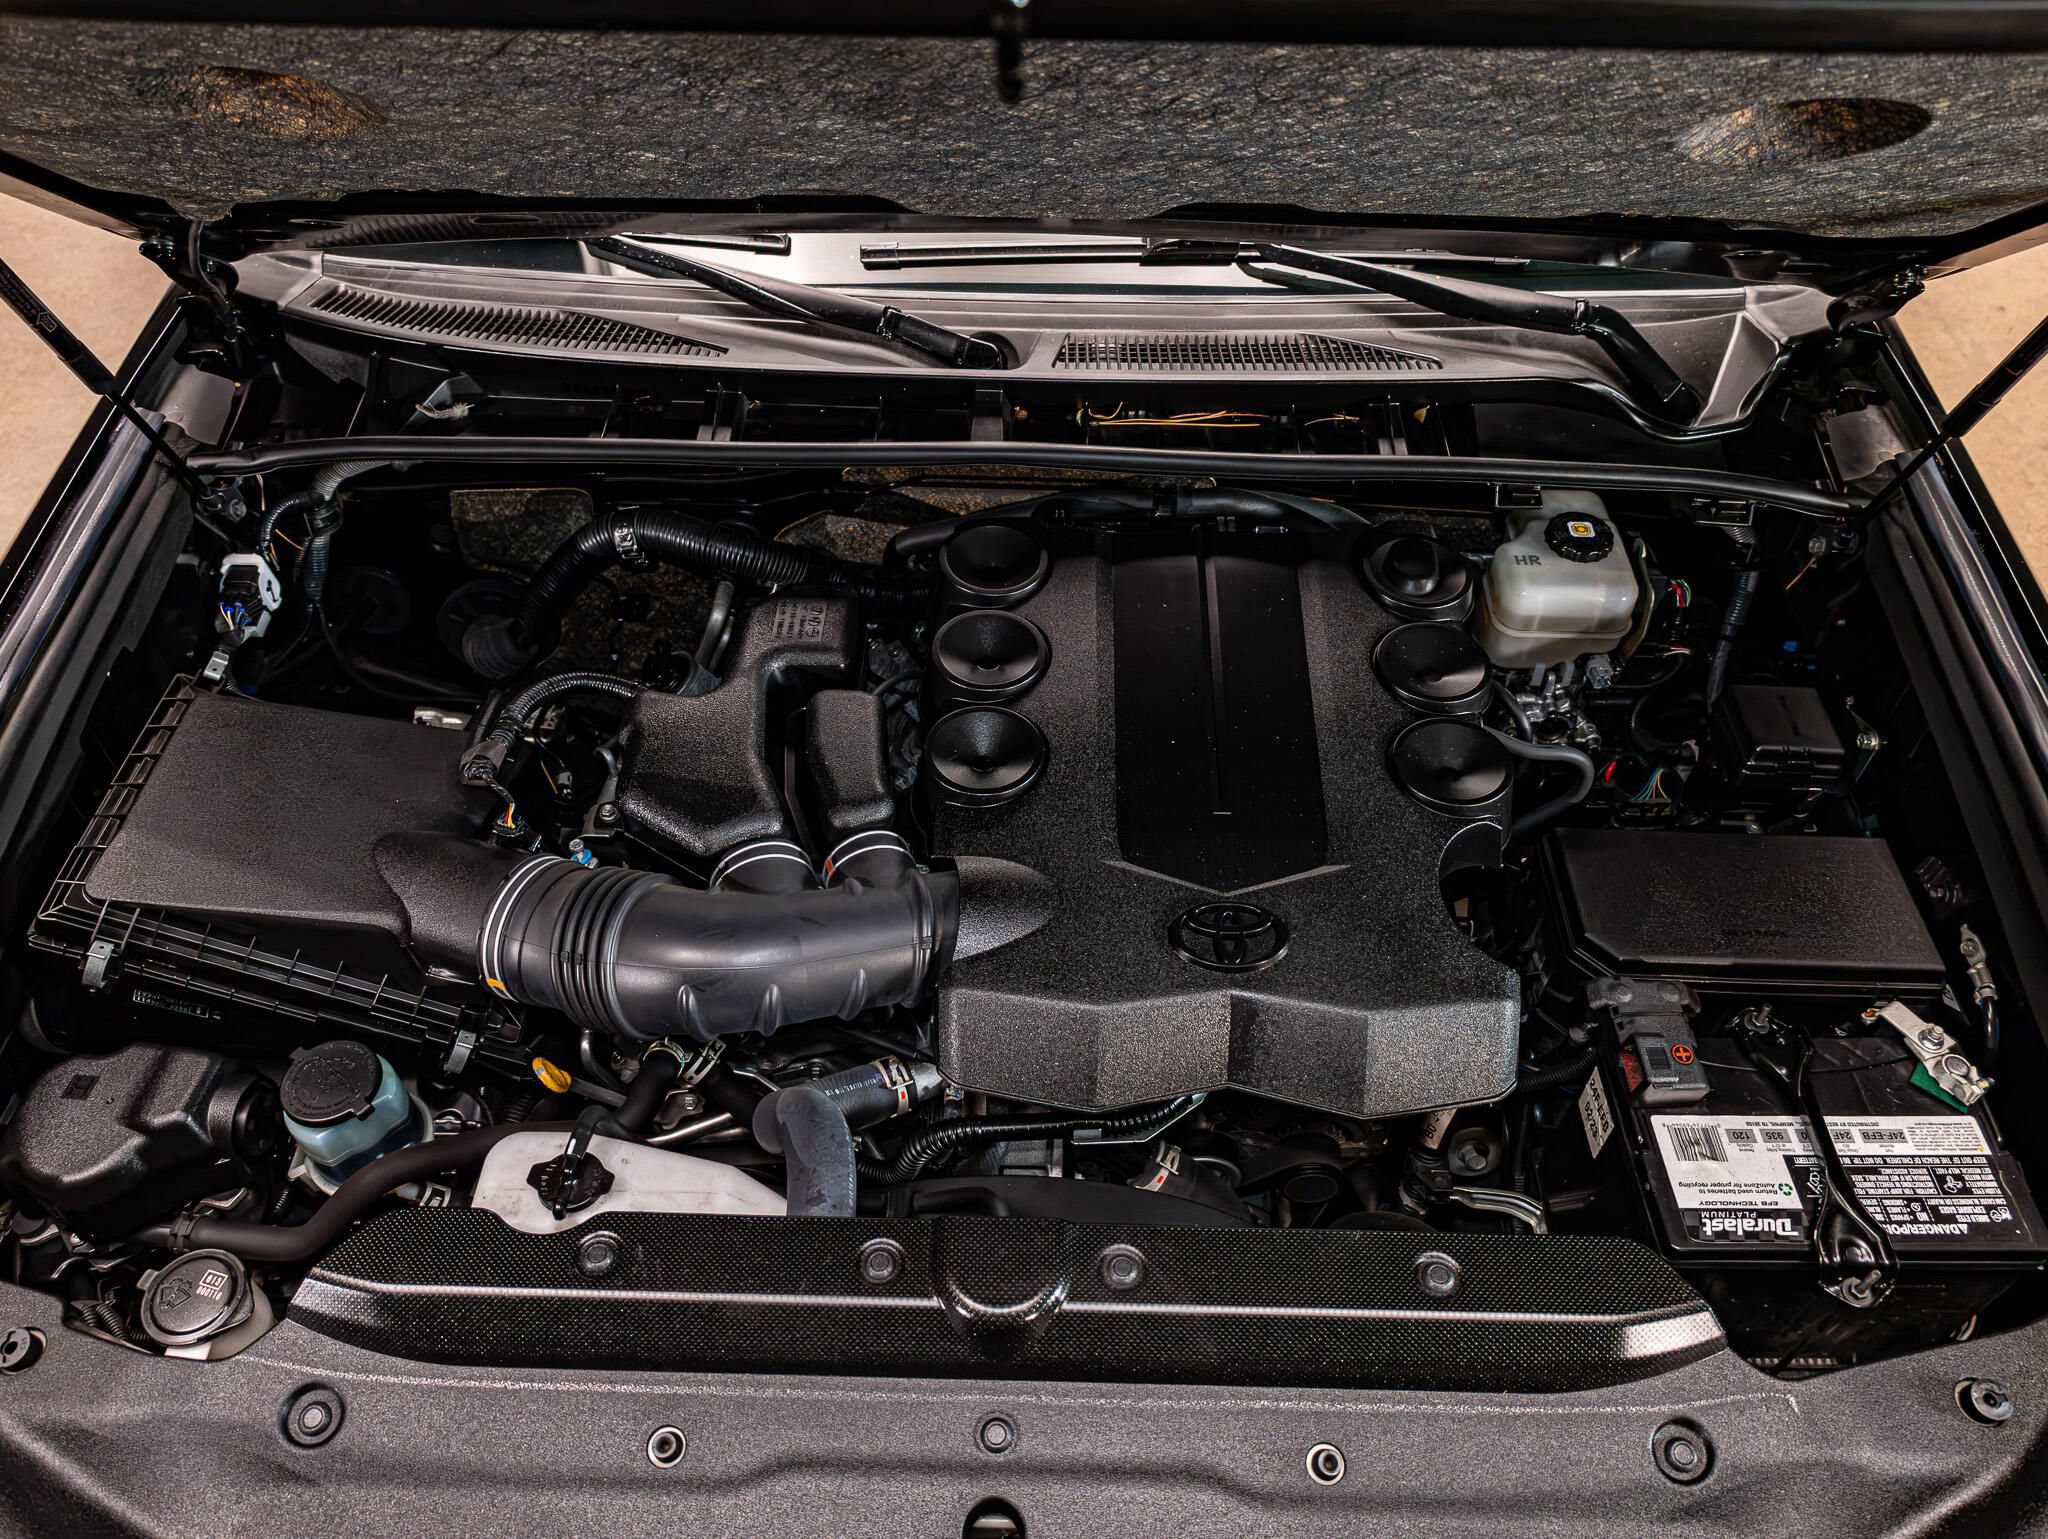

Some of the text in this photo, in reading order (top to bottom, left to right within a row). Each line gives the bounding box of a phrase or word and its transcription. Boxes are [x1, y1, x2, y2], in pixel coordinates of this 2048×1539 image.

[1514, 555, 1542, 566] HR
[1917, 1212, 1929, 1221] NO
[1702, 1218, 1798, 1236] Duralast
